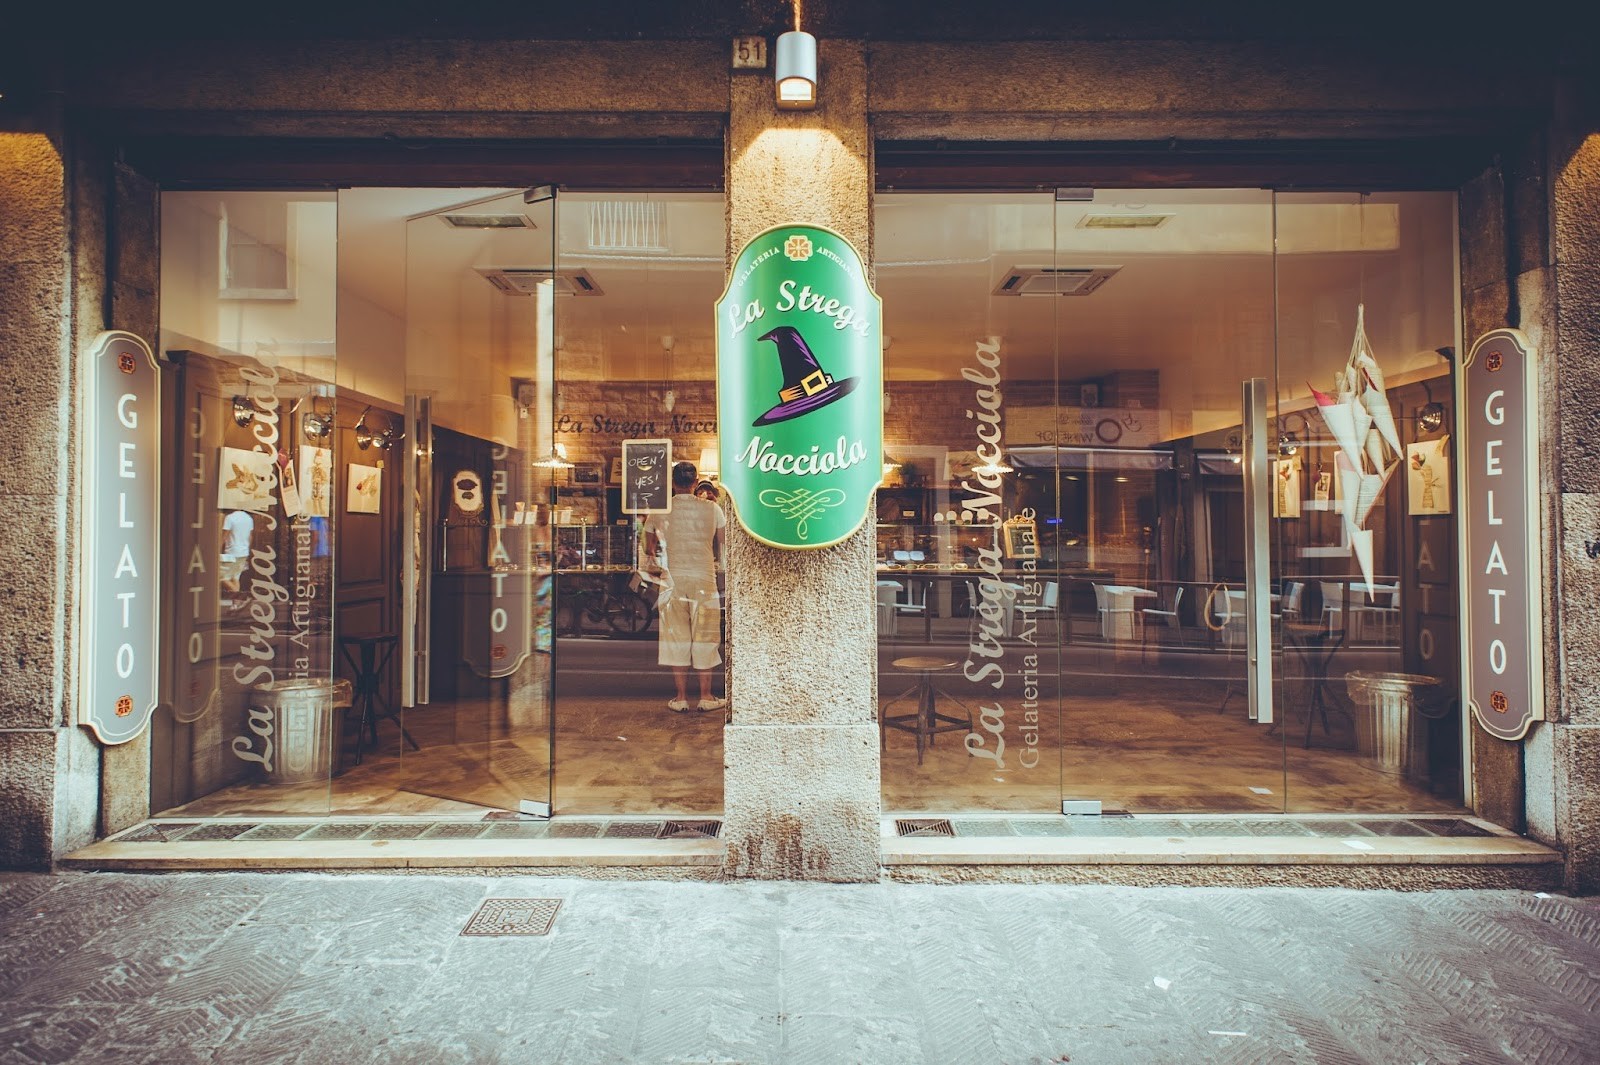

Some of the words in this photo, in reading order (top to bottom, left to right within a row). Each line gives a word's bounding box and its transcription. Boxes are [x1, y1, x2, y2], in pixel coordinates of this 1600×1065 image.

[739, 41, 760, 60] 51
[728, 298, 765, 339] La
[776, 280, 871, 337] Strega
[556, 414, 584, 433] La
[590, 414, 656, 439] Strega
[664, 414, 718, 433] Nocci
[634, 472, 661, 491] YES!
[734, 435, 868, 476] Nocciola
[960, 337, 1004, 529] Nocciola
[114, 393, 138, 679] GELATO
[287, 508, 316, 645] Artigianale
[1017, 506, 1043, 646] Artigianale
[1484, 390, 1508, 675] GELATO
[233, 545, 289, 691] Strega
[964, 542, 1017, 689] Strega
[231, 704, 275, 772] La
[963, 701, 1006, 769] La
[1017, 653, 1041, 769] Gelateria
